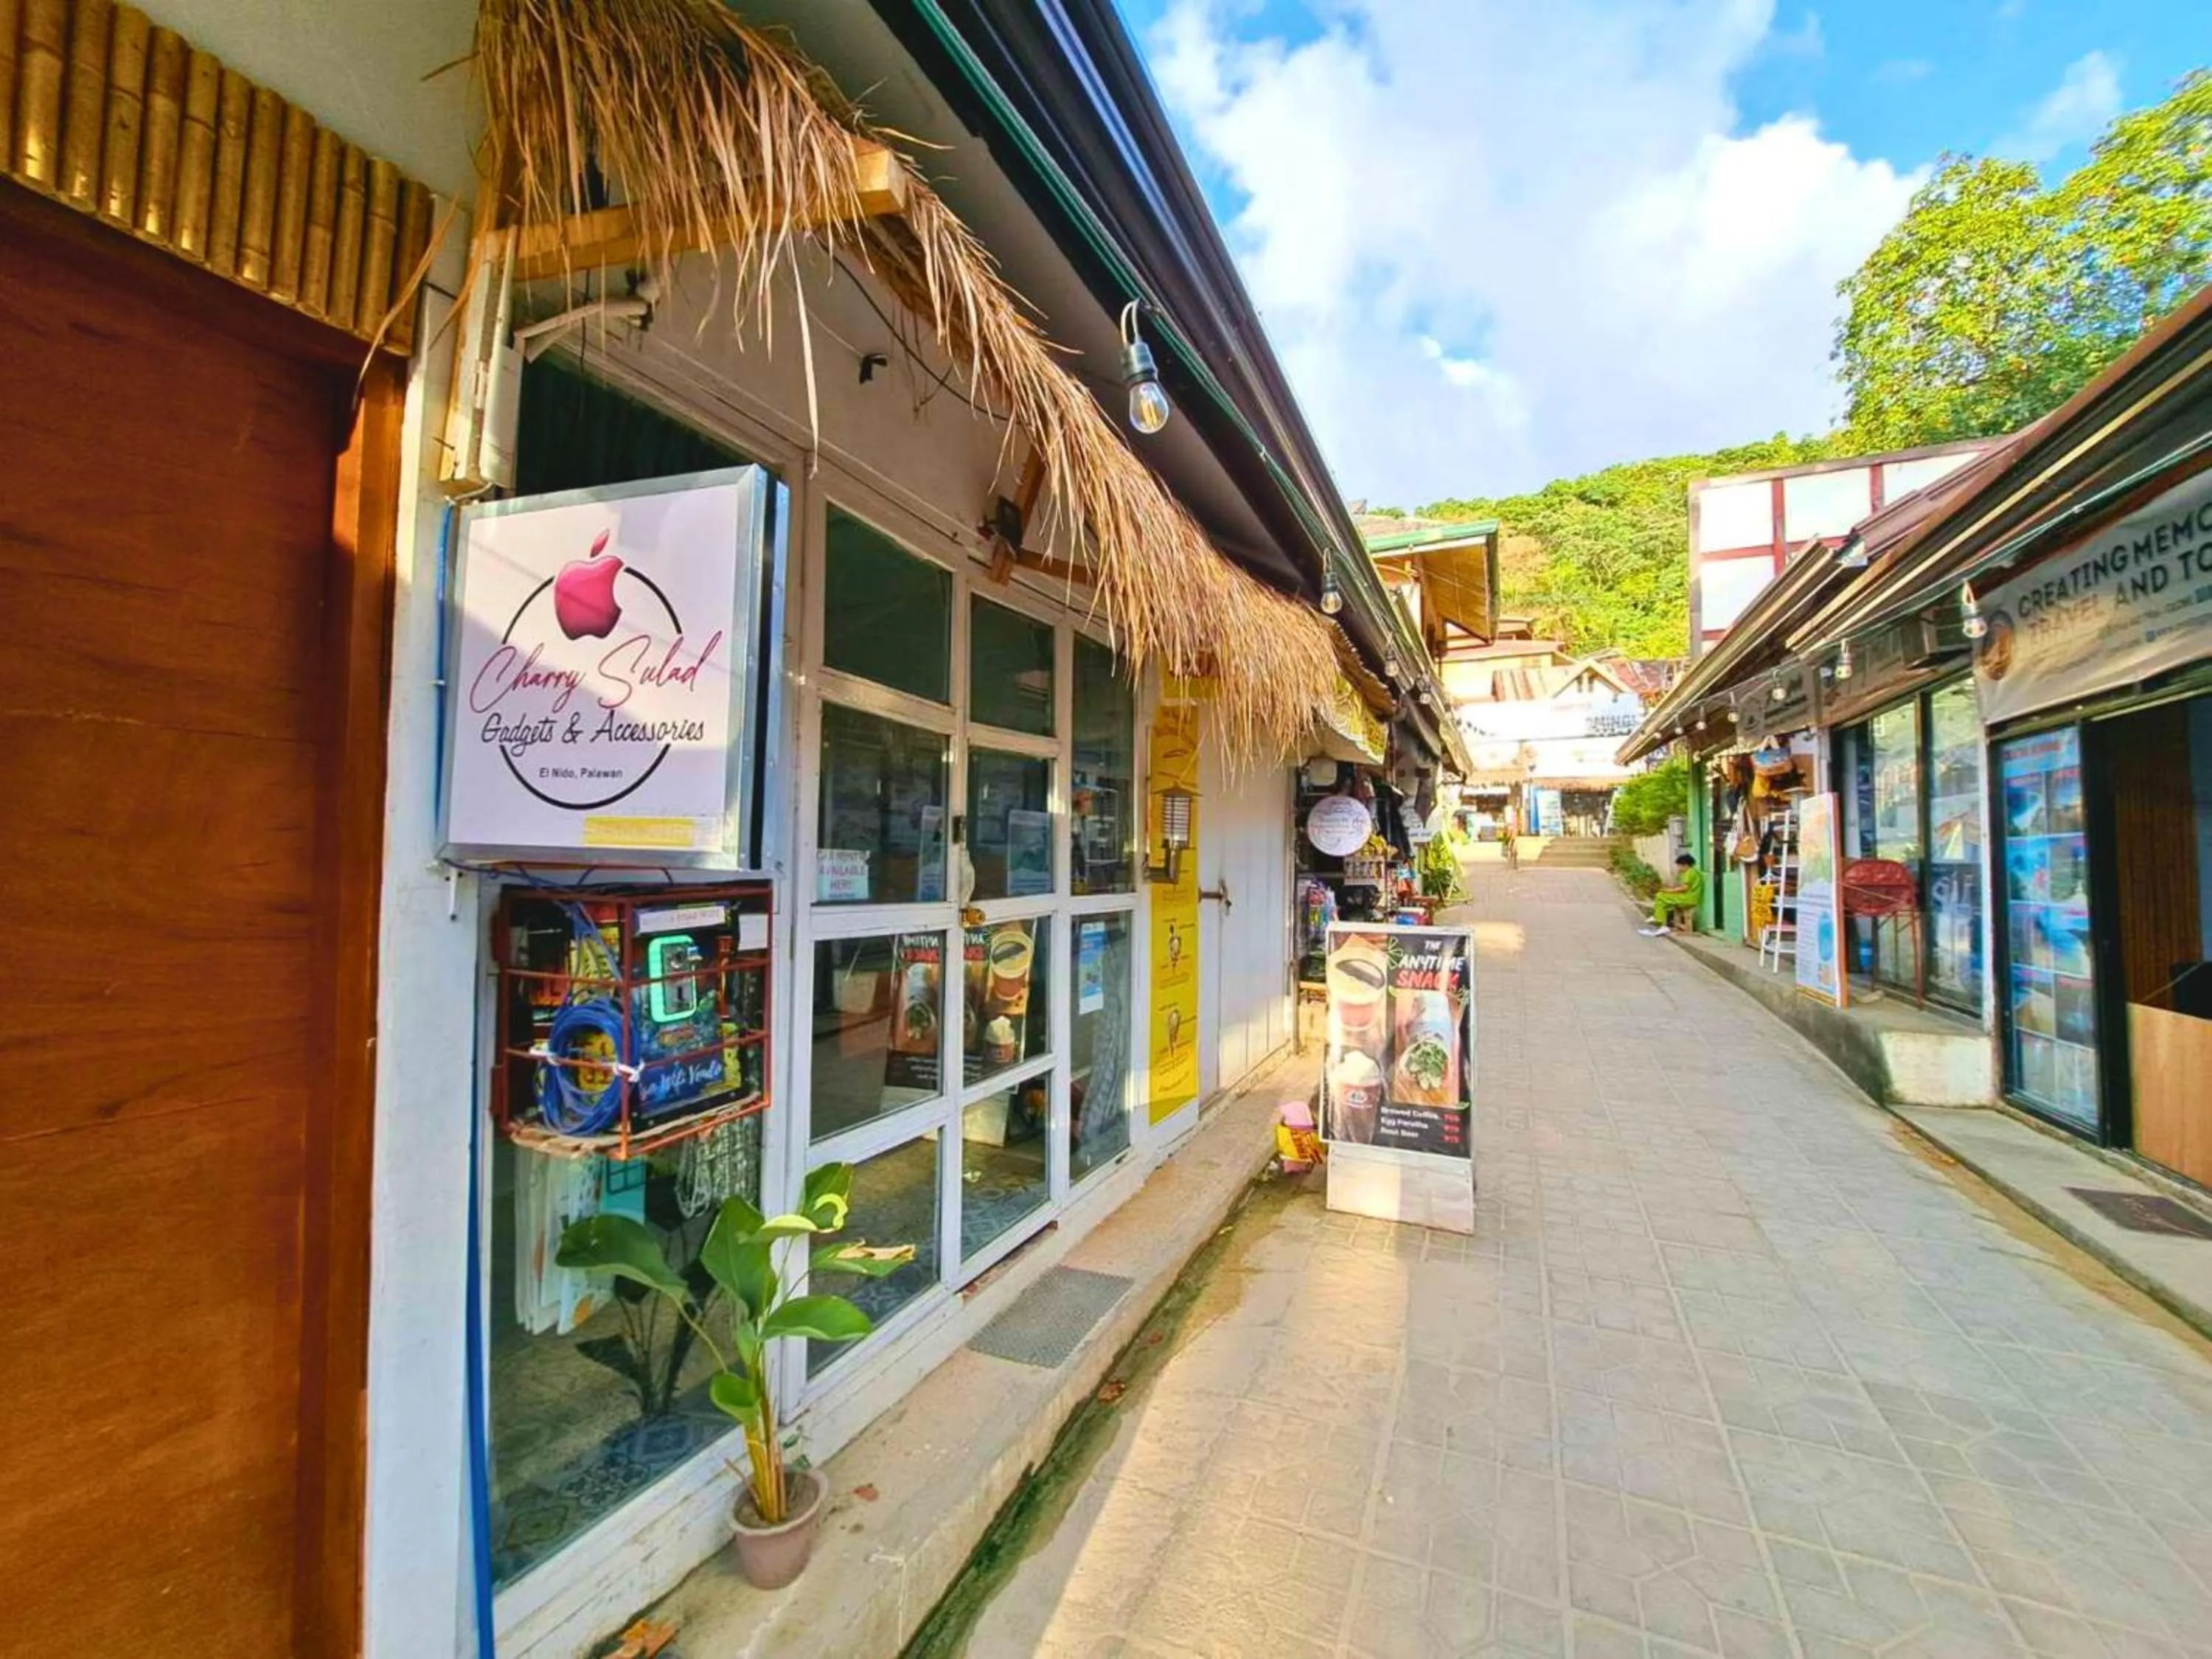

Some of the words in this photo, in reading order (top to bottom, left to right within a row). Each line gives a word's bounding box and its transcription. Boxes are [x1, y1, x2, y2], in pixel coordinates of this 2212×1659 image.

[2018, 544, 2129, 618] CREATING
[2115, 565, 2168, 610] AND
[470, 642, 586, 714] Charry
[481, 712, 557, 757] Gadgets
[562, 711, 584, 744] &
[590, 709, 704, 742] Accessories
[539, 768, 549, 777] El
[552, 768, 577, 779] Nido,
[580, 768, 623, 778] Palawan
